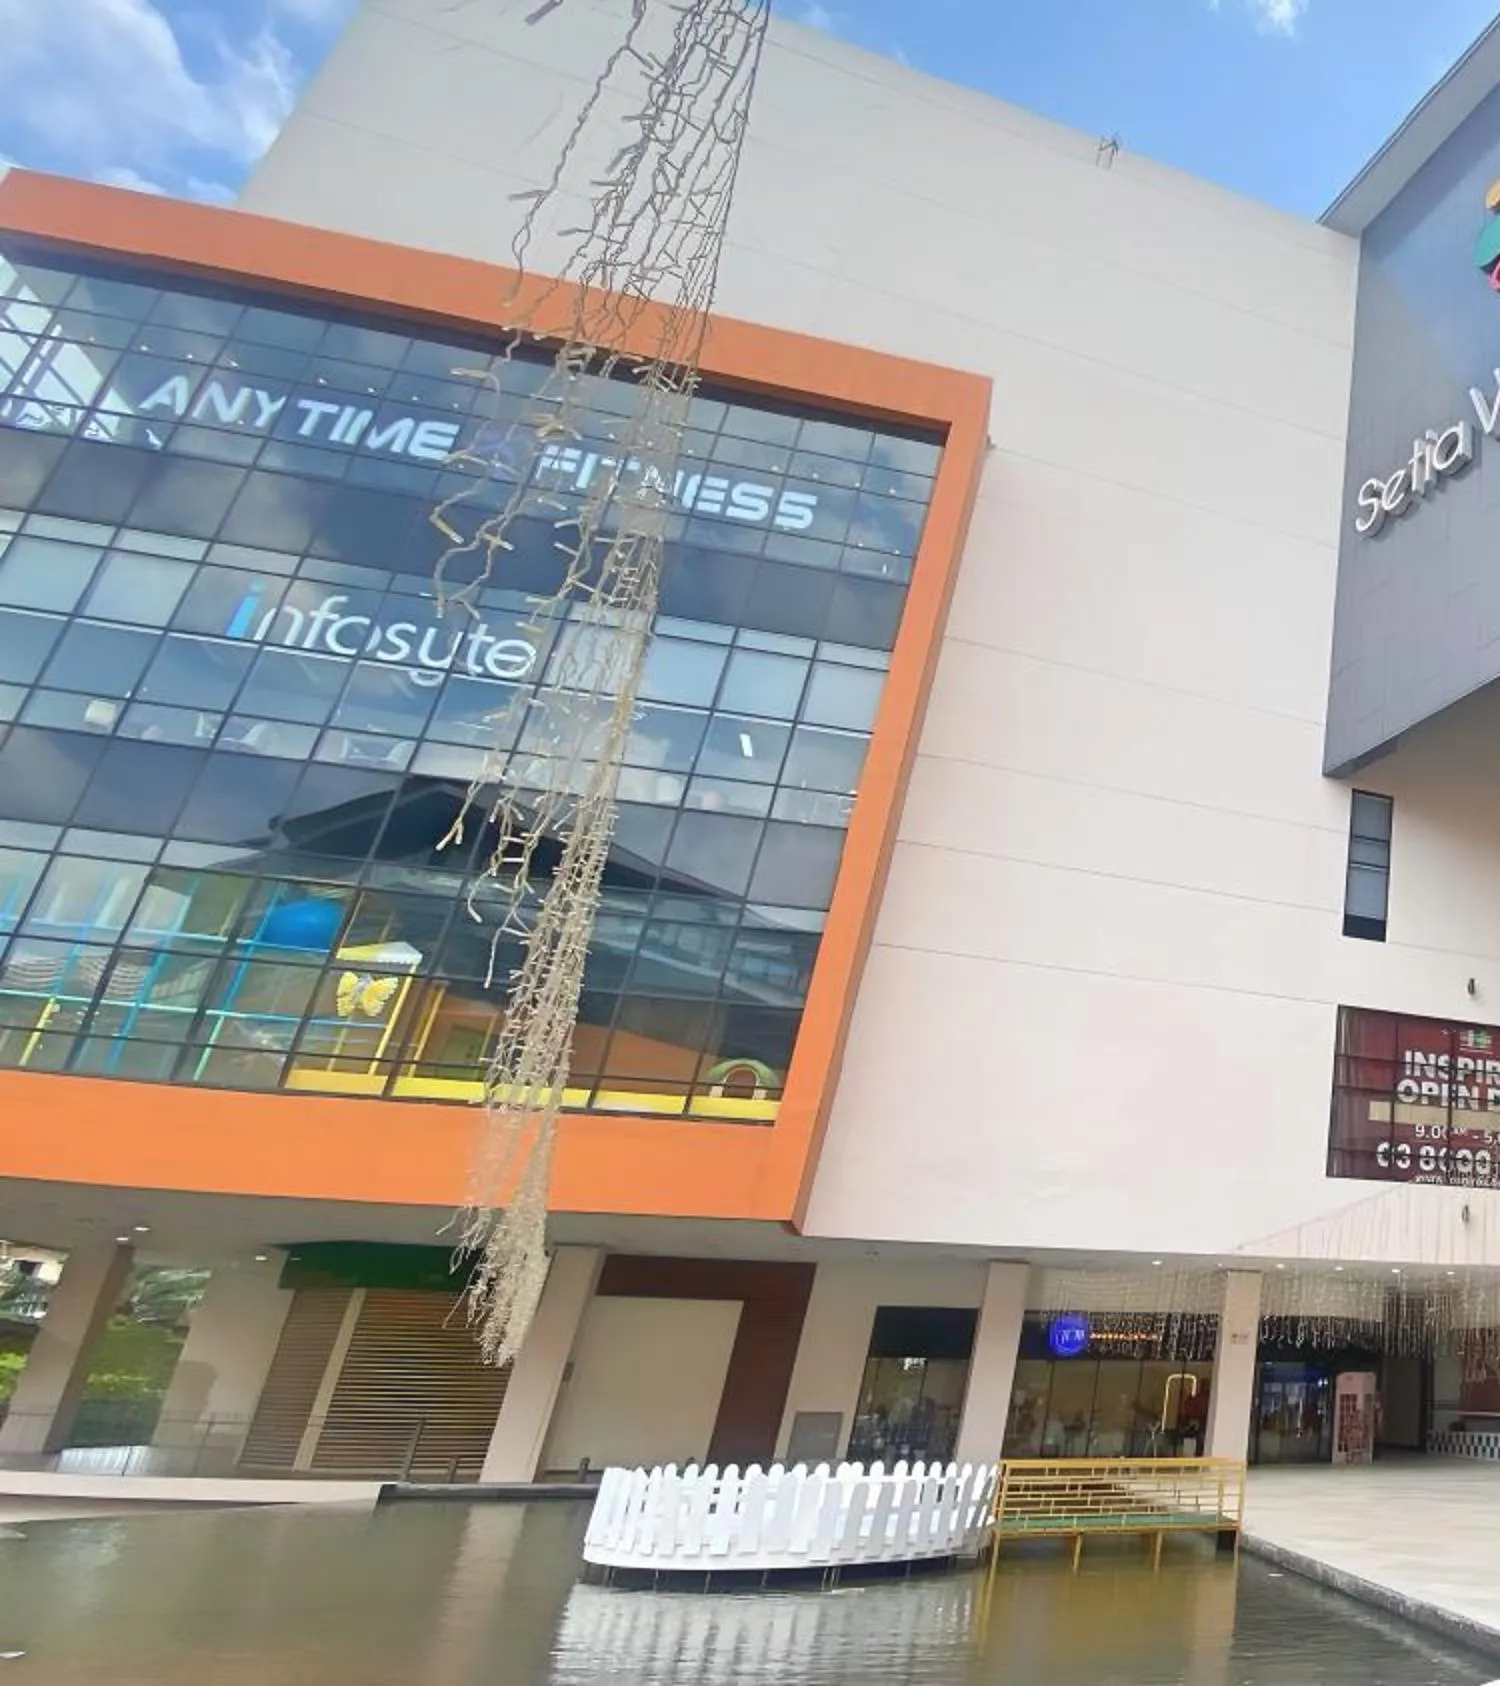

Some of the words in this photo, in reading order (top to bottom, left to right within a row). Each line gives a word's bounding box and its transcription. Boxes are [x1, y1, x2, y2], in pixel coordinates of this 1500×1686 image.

[139, 375, 460, 460] ANYTIME
[1356, 420, 1472, 535] Setia
[1397, 1078, 1479, 1112] OPEN
